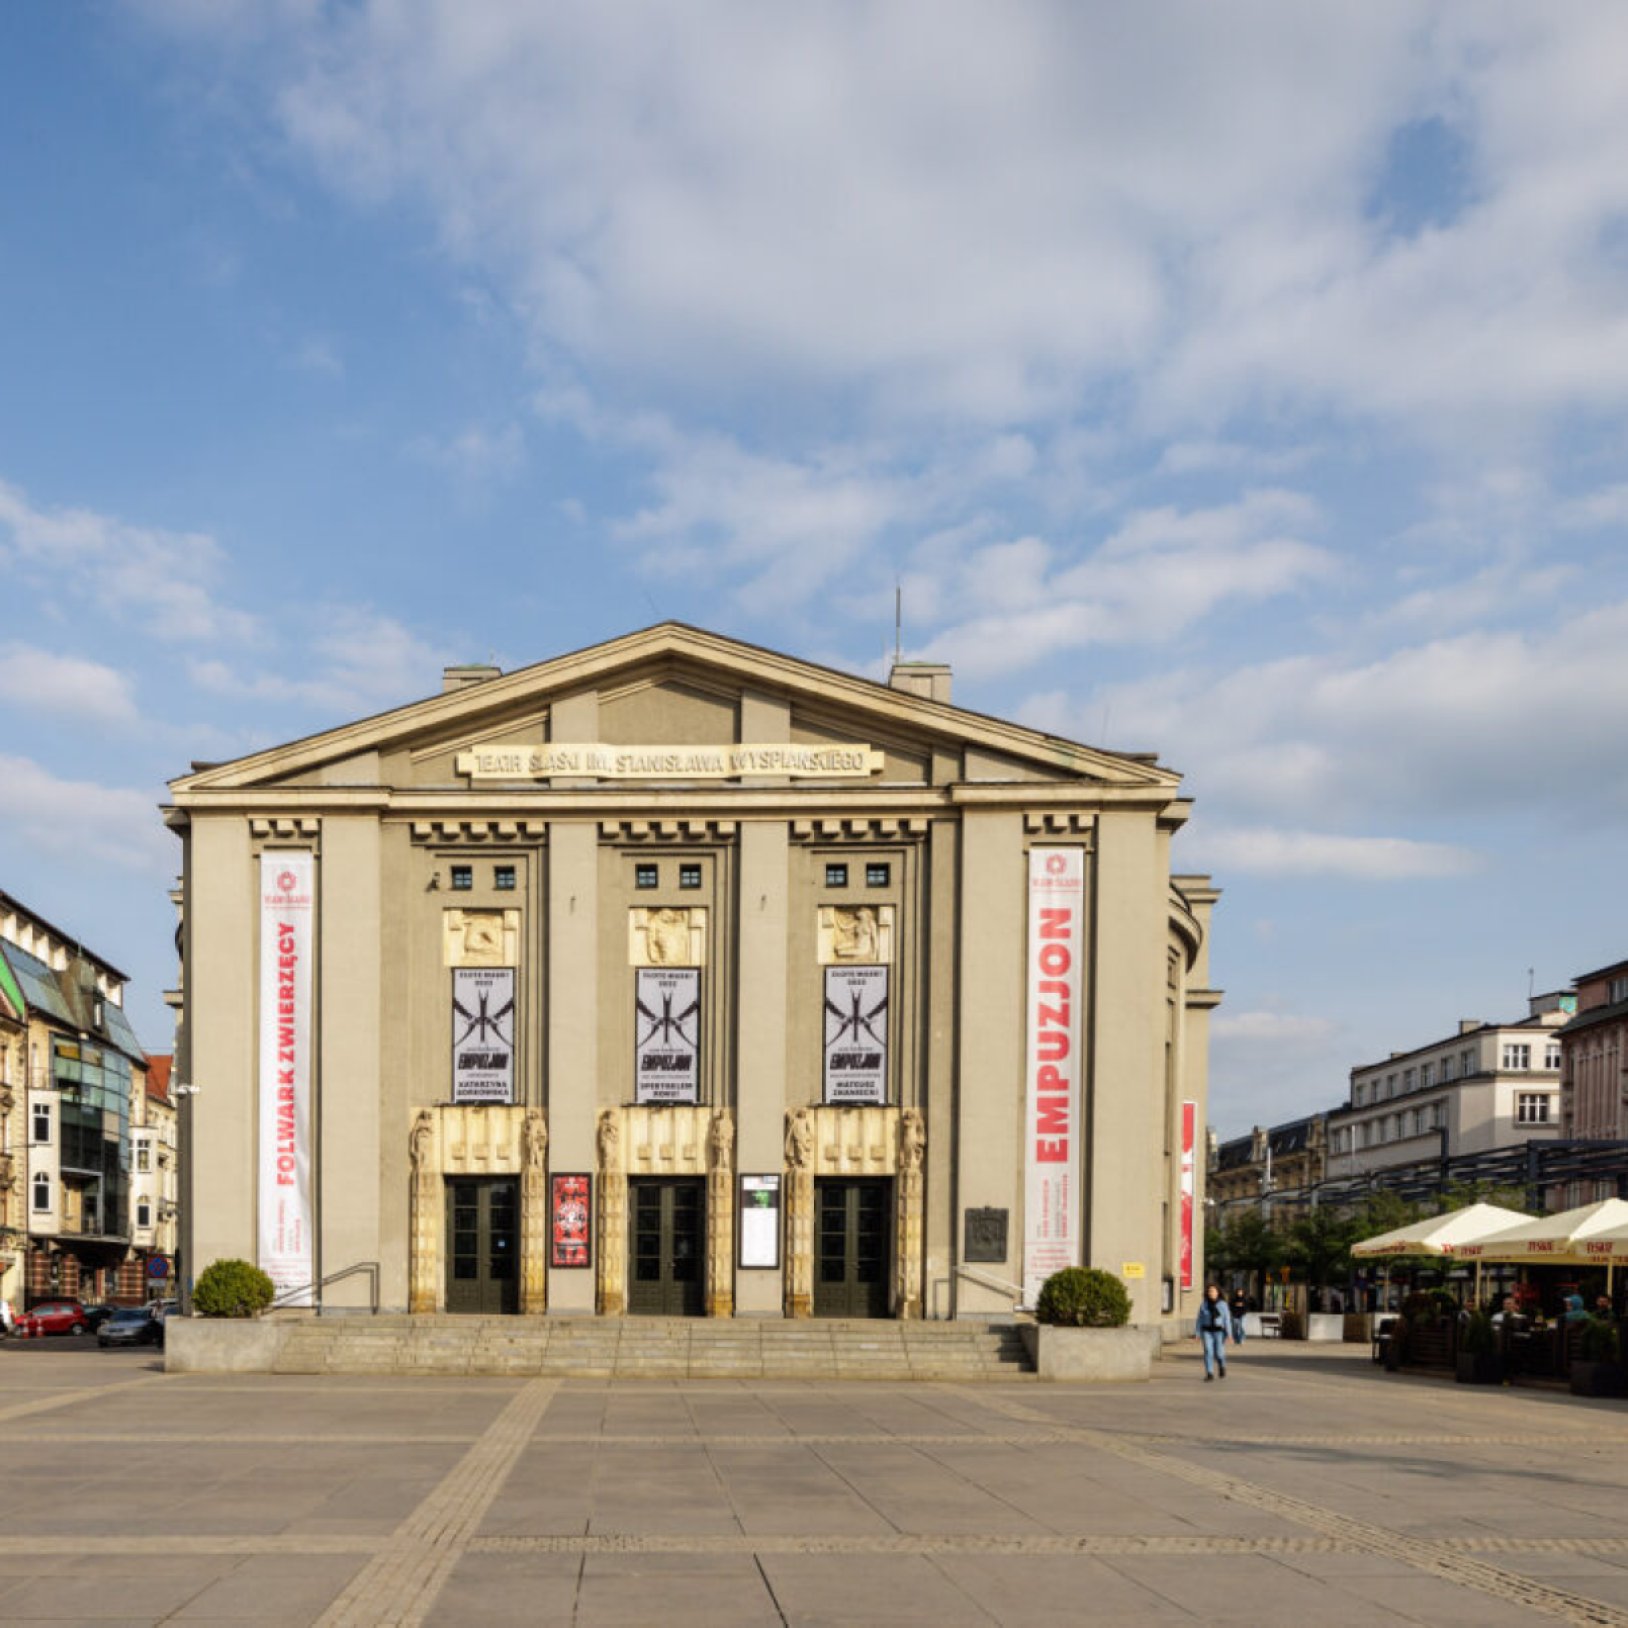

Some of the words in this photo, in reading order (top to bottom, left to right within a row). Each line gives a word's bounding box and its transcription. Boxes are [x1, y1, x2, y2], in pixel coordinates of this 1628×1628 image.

[475, 754, 522, 773] TEATR
[615, 754, 724, 773] STANISŁAWA
[278, 922, 298, 1063] ZWIERZĘCY
[1036, 908, 1071, 1163] EMPUZJON
[276, 1069, 296, 1187] FOLWARK
